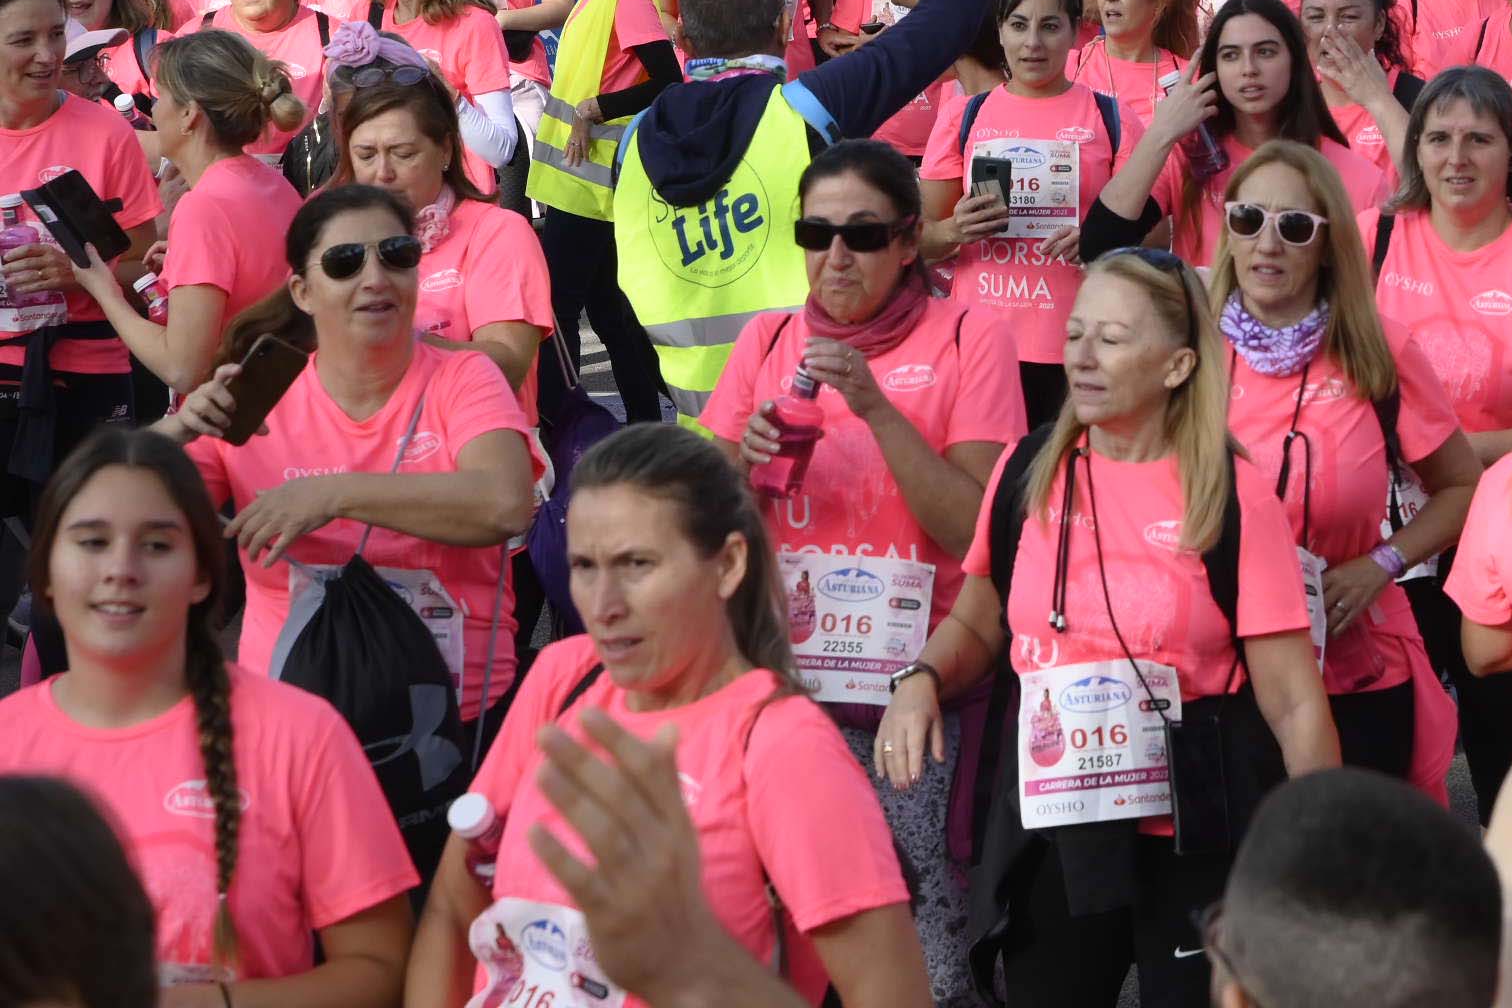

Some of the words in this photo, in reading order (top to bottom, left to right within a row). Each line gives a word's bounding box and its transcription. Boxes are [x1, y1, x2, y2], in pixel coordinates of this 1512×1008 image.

[672, 189, 765, 267] Life
[978, 272, 1053, 300] SUMA
[824, 578, 880, 595] ASTURIANA
[821, 612, 873, 635] 016
[822, 640, 864, 654] 22355
[850, 660, 882, 671] MUJER
[1064, 690, 1129, 706] ASTURIANA
[1070, 723, 1129, 750] 016
[1077, 754, 1123, 770] 21587
[1038, 777, 1082, 792] CARRERA
[1083, 776, 1098, 787] DE
[1099, 774, 1113, 785] LA
[1114, 772, 1149, 784] MUJER
[1036, 800, 1086, 816] OYSHO
